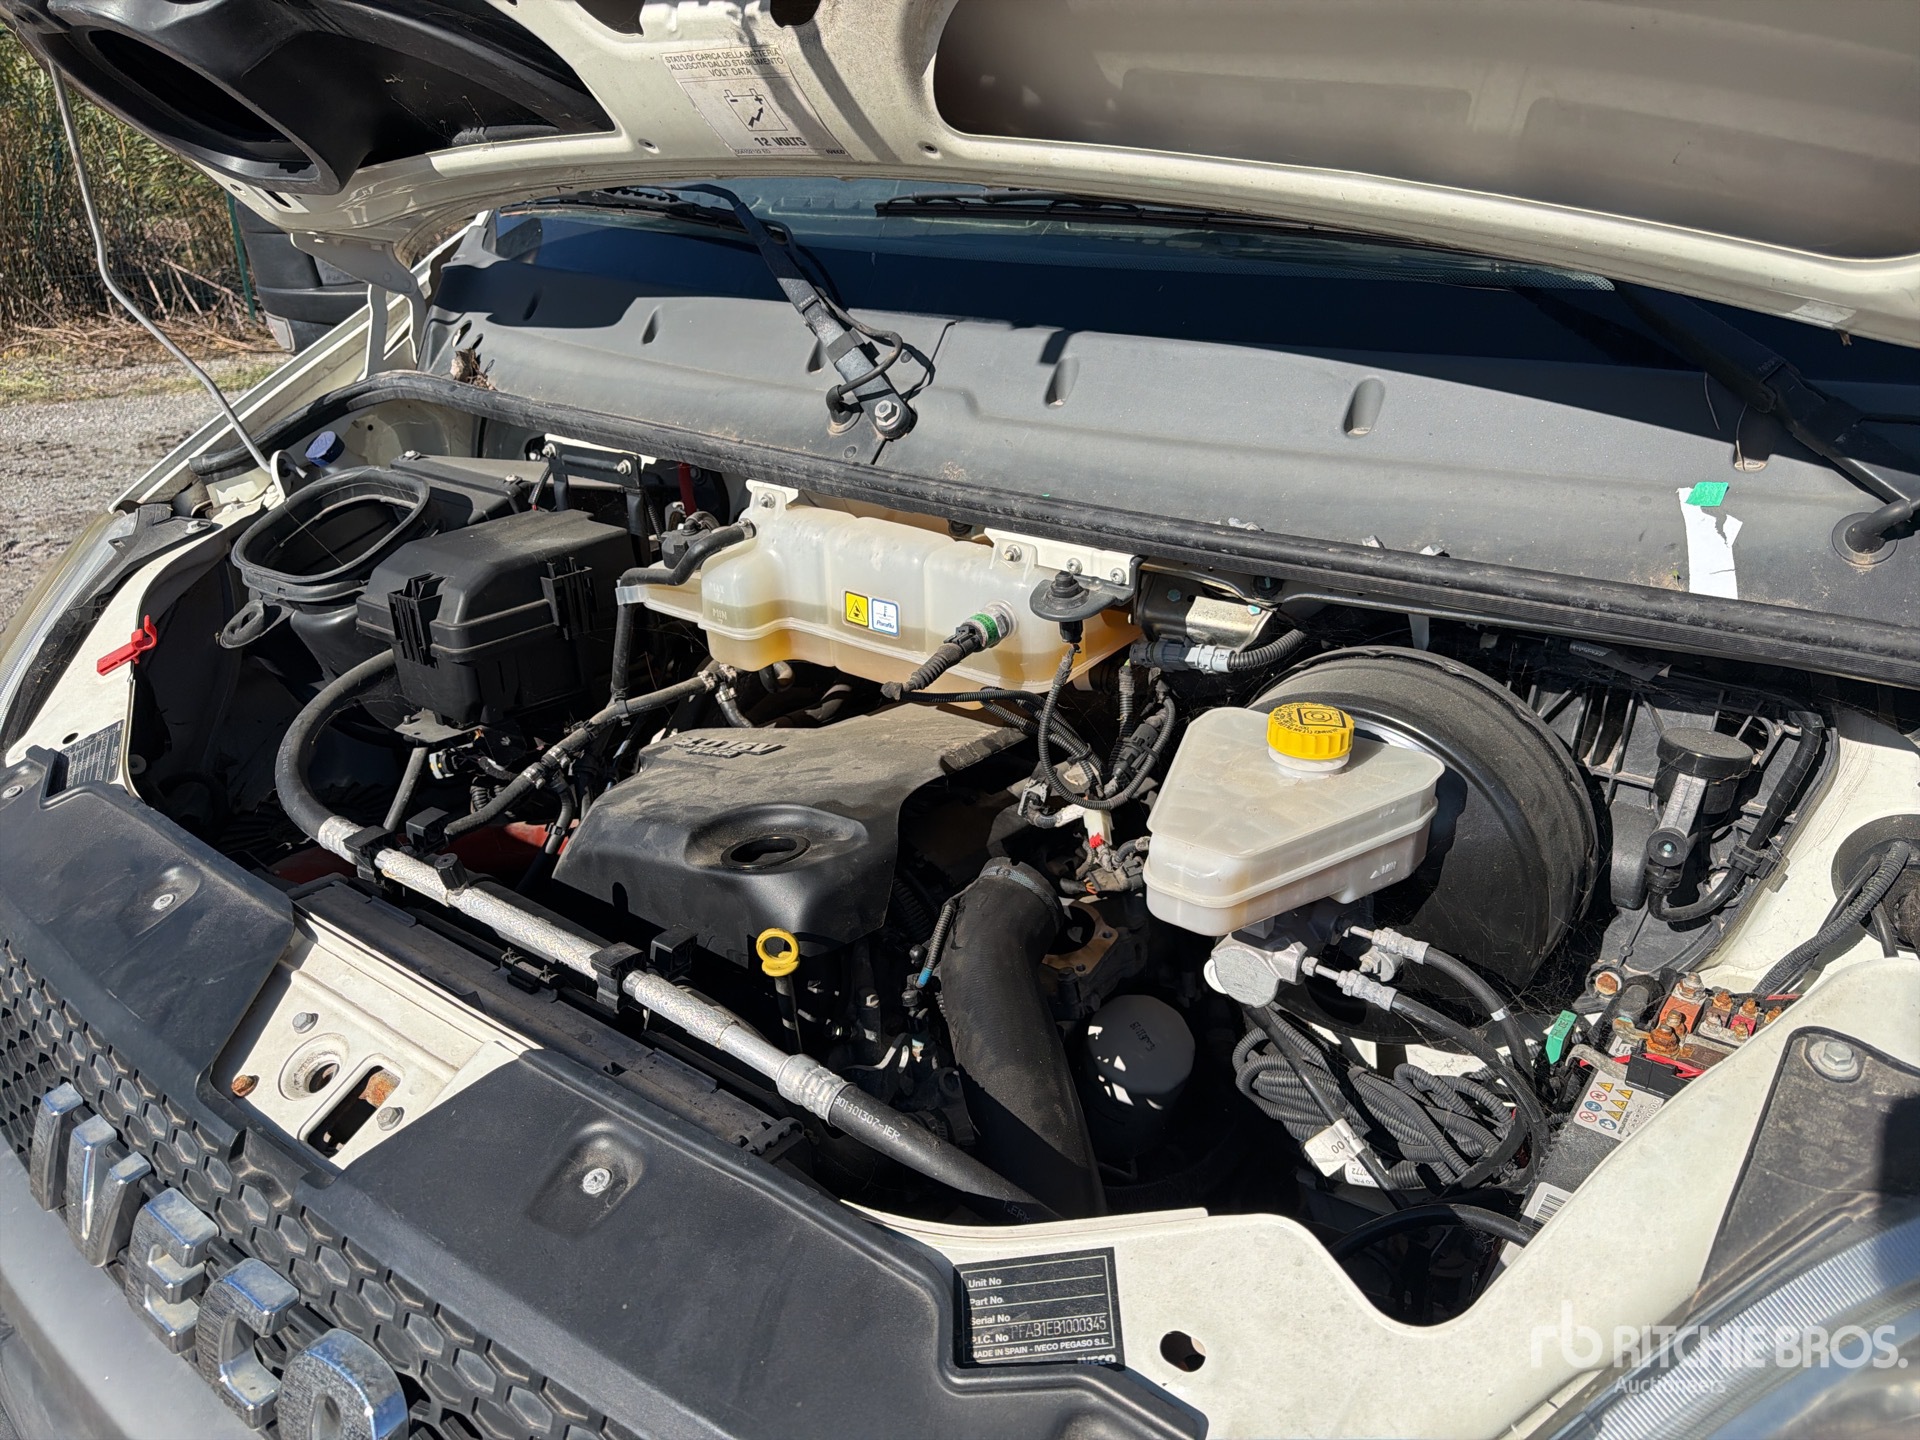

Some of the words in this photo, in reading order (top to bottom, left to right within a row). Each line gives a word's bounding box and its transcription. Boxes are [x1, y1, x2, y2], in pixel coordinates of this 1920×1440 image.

[694, 52, 721, 62] CARICA
[722, 50, 744, 60] DELLA
[744, 49, 781, 59] BATTERIA
[707, 60, 732, 69] DALLO
[732, 57, 784, 67] STABILIMENTO
[709, 68, 728, 78] VOLT
[733, 67, 752, 77] DATA
[754, 137, 771, 147] 12
[771, 136, 807, 147] VOLTS
[30, 1082, 410, 1440] IVECO
[968, 1278, 987, 1288] Unit
[988, 1277, 1002, 1286] No
[969, 1296, 988, 1306] Part
[989, 1295, 1003, 1304] No
[970, 1315, 995, 1326] Serial
[997, 1314, 1011, 1323] No
[972, 1334, 993, 1344] P.I.C.
[995, 1334, 1009, 1343] No
[973, 1349, 993, 1358] MADE
[994, 1348, 1004, 1357] IN
[1004, 1346, 1028, 1355] SPAIN
[1034, 1343, 1059, 1353] IVECO
[1060, 1340, 1093, 1350] PEGASO
[1093, 1338, 1110, 1347] S.L.
